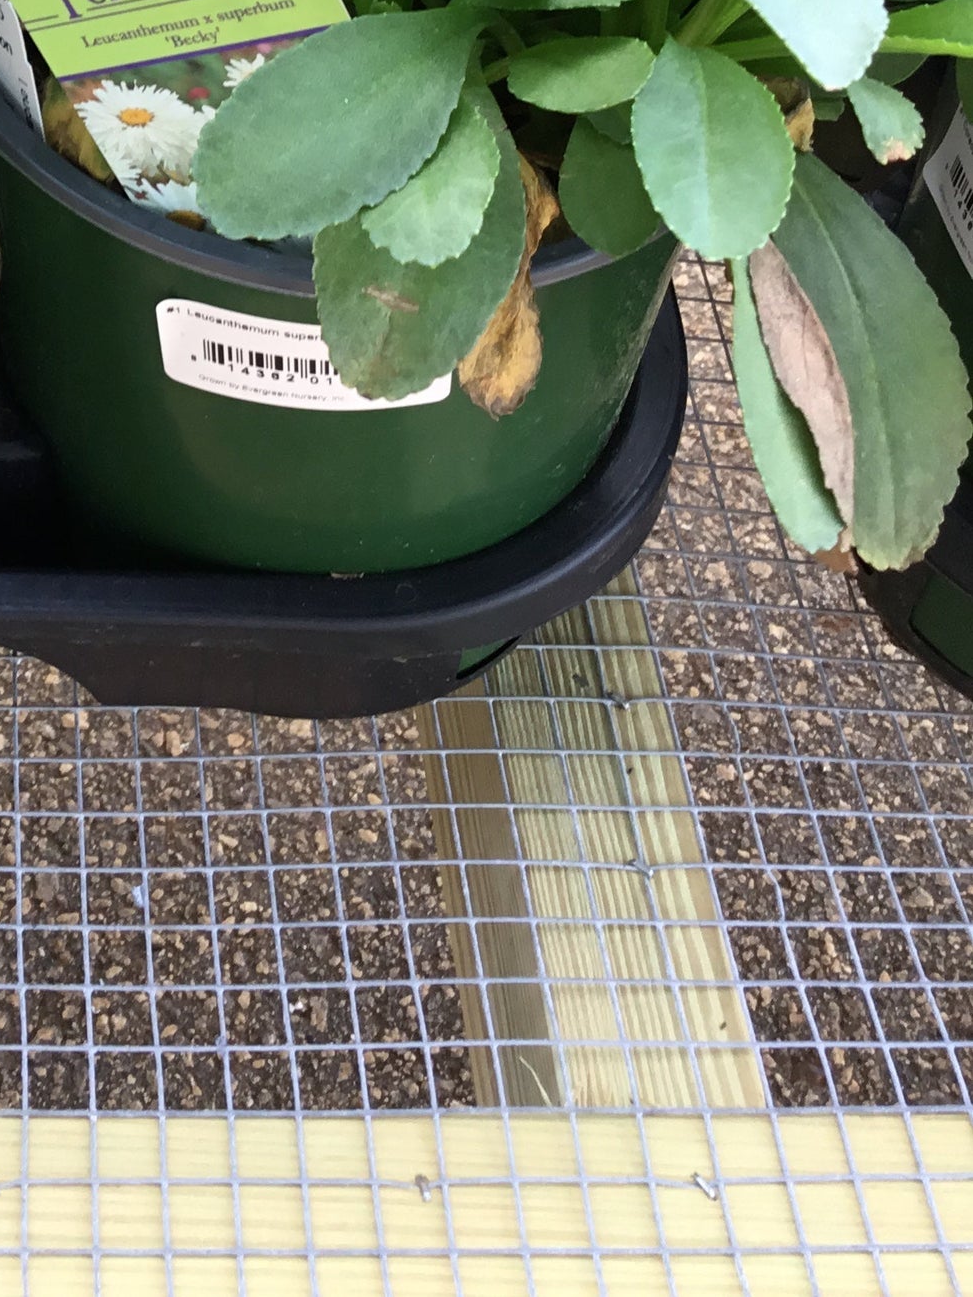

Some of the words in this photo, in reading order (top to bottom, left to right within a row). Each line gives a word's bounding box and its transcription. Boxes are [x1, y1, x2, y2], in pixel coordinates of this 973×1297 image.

[81, 17, 200, 48] Leucanthemum
[187, 308, 280, 337] Leucanthemum
[283, 331, 321, 342] super
